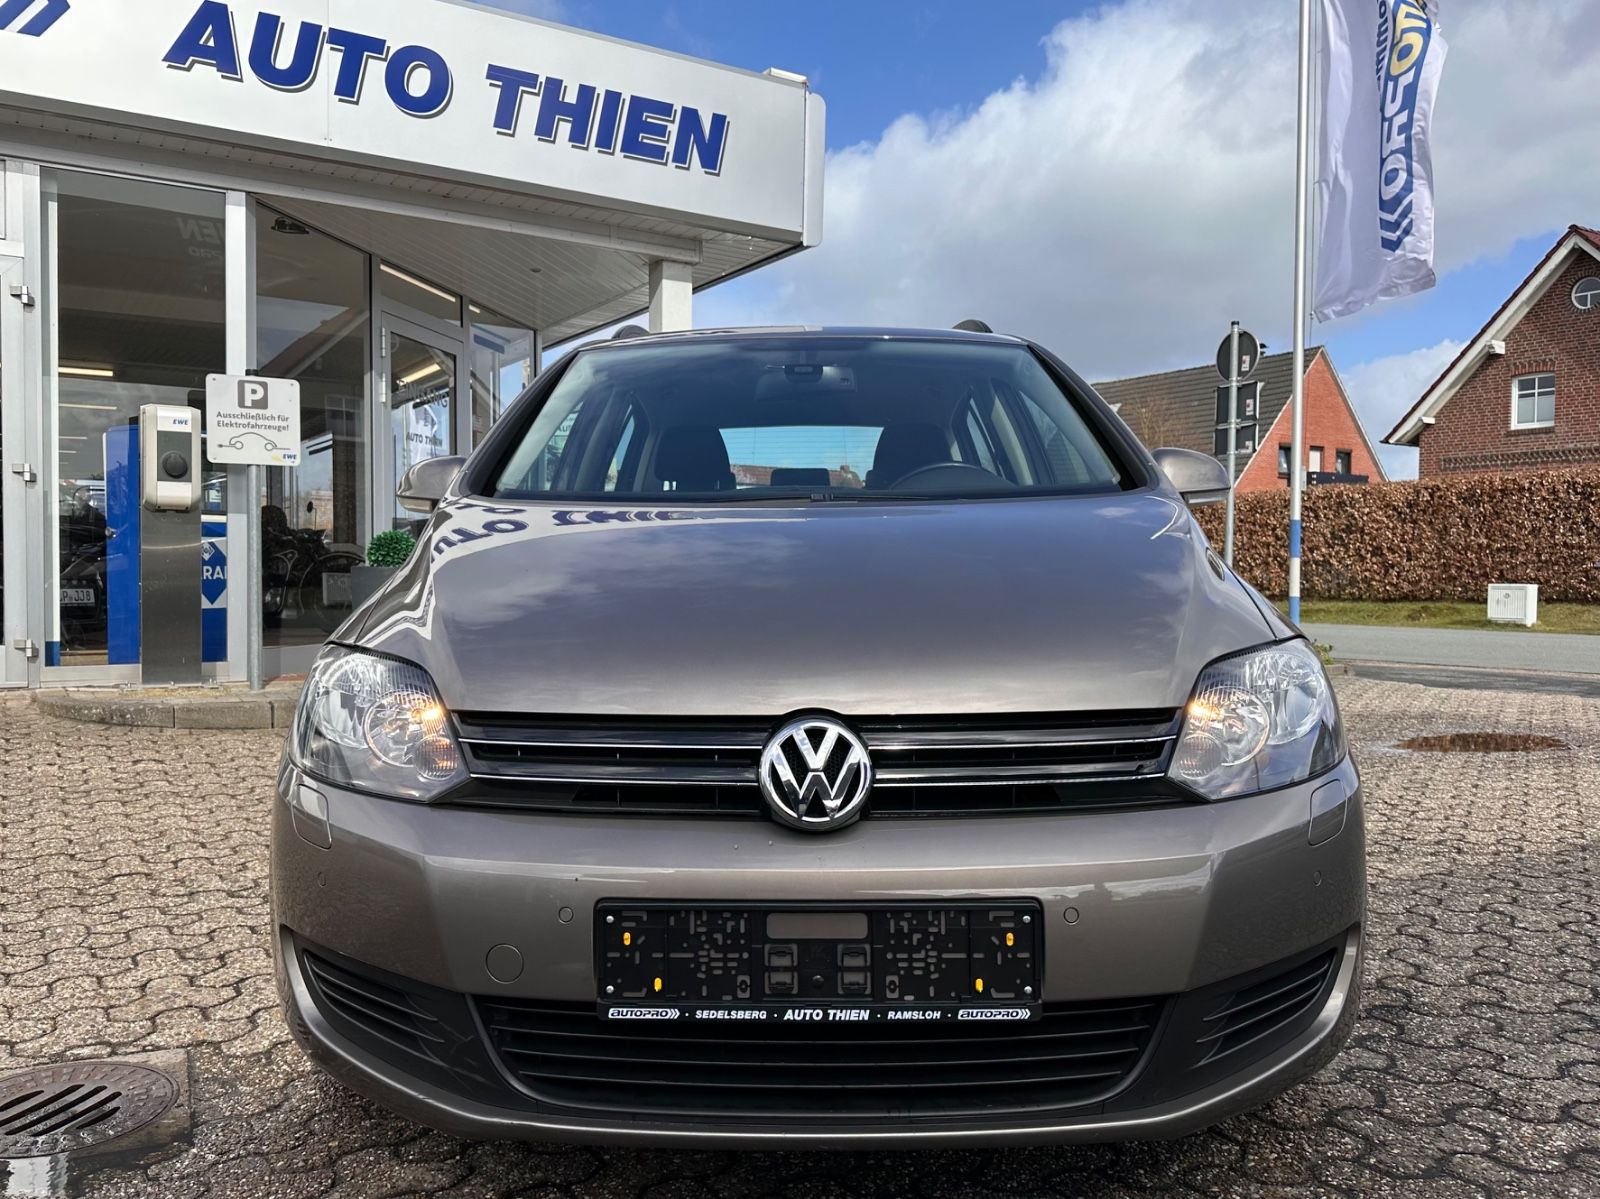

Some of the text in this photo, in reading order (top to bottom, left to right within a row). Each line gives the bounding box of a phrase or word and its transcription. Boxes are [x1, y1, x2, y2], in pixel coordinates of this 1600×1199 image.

[161, 0, 731, 177] AUTO THIEN
[244, 382, 265, 407] P
[172, 418, 190, 426] EWE
[216, 411, 290, 423] Ausschließlich für
[217, 420, 289, 433] Elektrofahrzeuge!
[282, 453, 297, 461] EWE
[695, 1010, 767, 1020] SEDELSBERG
[783, 1009, 823, 1020] AUTO
[827, 1009, 870, 1021] THIEN
[887, 1010, 941, 1020] RAMSLOH
